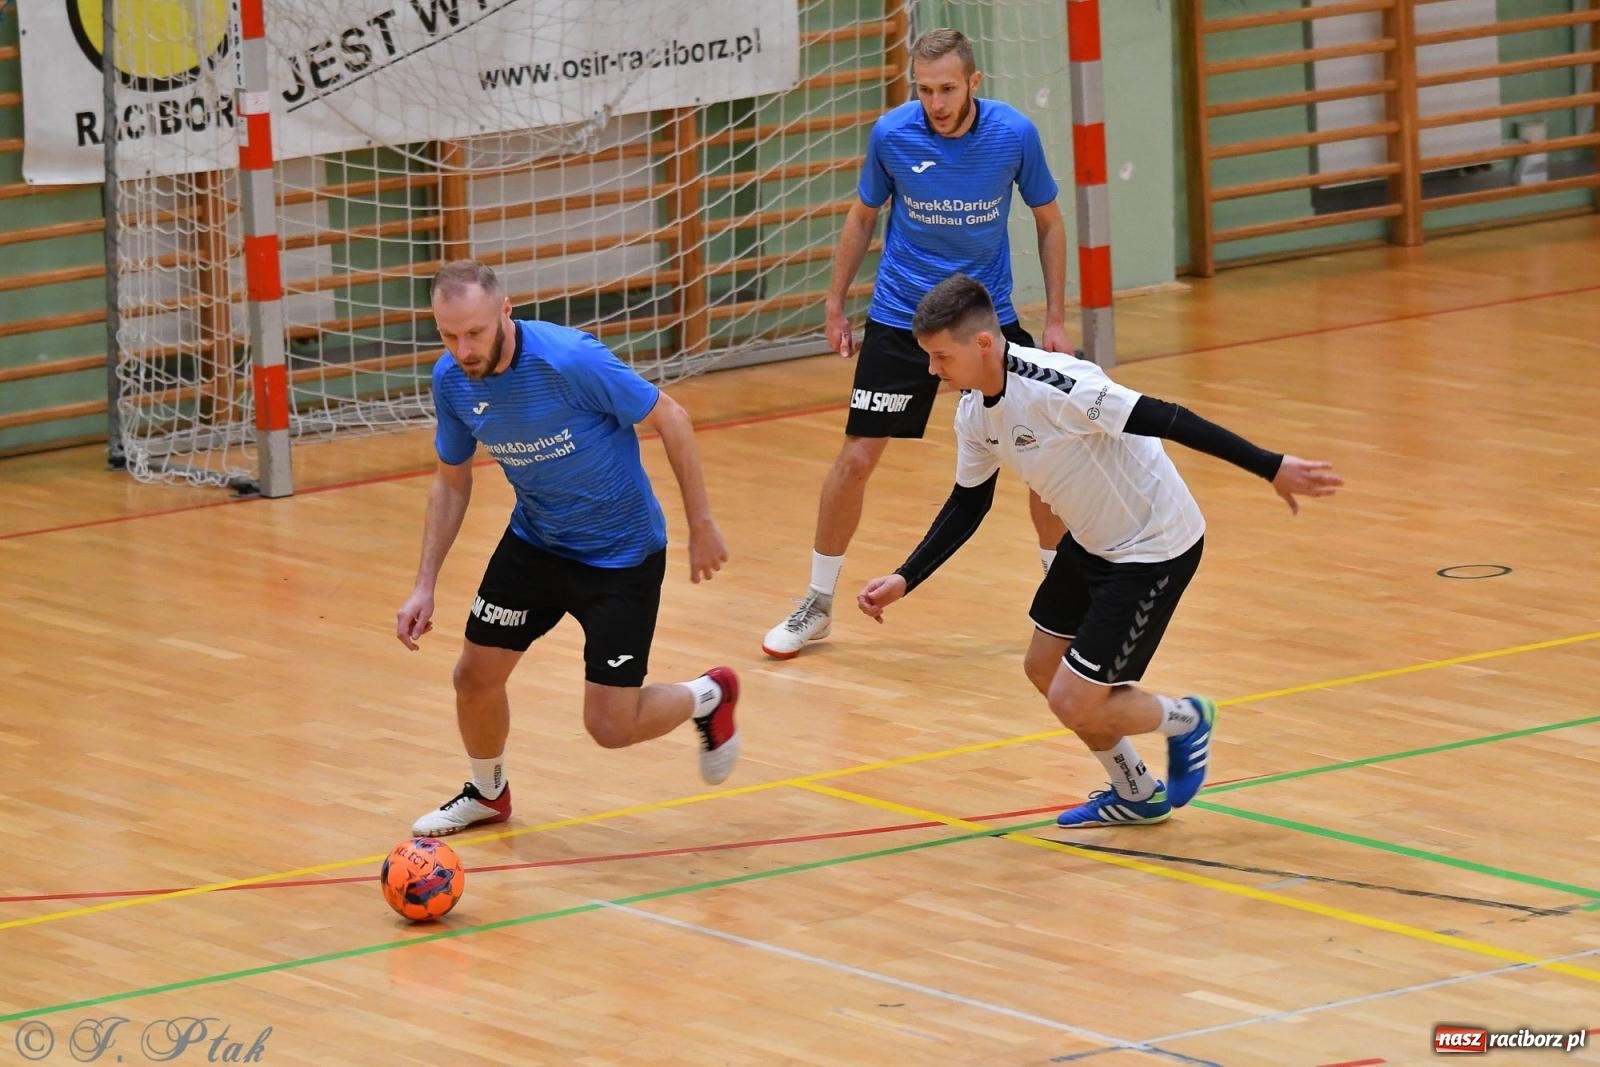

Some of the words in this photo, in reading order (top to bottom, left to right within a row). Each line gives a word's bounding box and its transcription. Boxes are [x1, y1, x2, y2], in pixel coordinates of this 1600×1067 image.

[281, 8, 396, 103] JEST
[478, 27, 761, 91] www.osir-raciborz.pl
[966, 208, 1000, 225] GmbH
[870, 392, 914, 413] SPORT
[534, 441, 576, 463] GmbH
[482, 603, 531, 627] SPORT
